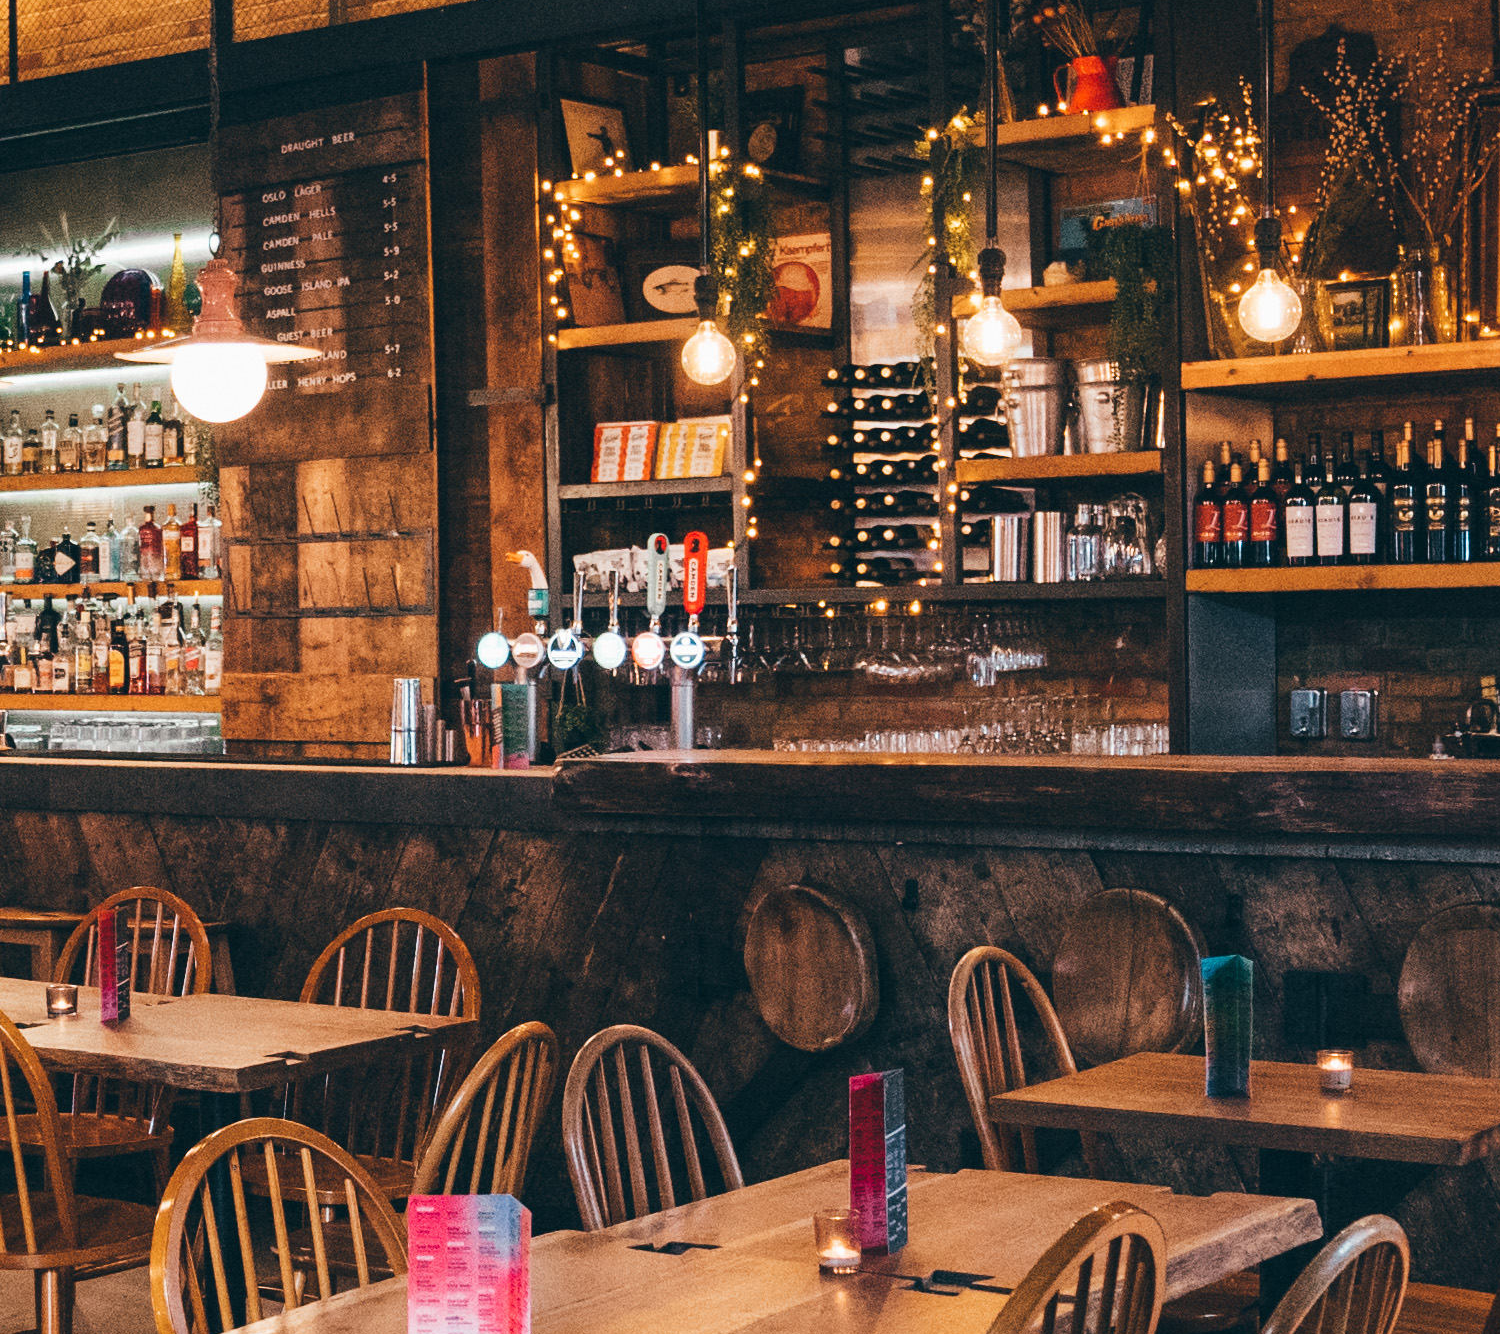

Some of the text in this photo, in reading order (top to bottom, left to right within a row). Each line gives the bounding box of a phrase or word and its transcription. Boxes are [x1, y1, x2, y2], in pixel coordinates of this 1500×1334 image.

[281, 132, 355, 154] DRAUGHT BEER
[262, 190, 286, 203] OSLO
[294, 184, 321, 197] LAGER
[262, 212, 300, 227] CAMDEN
[309, 206, 336, 219] HELLS
[262, 236, 299, 250] CAMDEN
[311, 230, 334, 242] PALE
[261, 259, 306, 274] GUINNESS
[264, 284, 293, 296] GOOSE
[301, 279, 333, 291] ISLAND
[337, 276, 350, 288] IPA
[266, 307, 296, 319] ASPALL
[277, 327, 333, 342] GUEST BEER
[298, 375, 328, 388] HENRY
[333, 371, 357, 385] HOPS
[689, 560, 698, 601] CAMDEN
